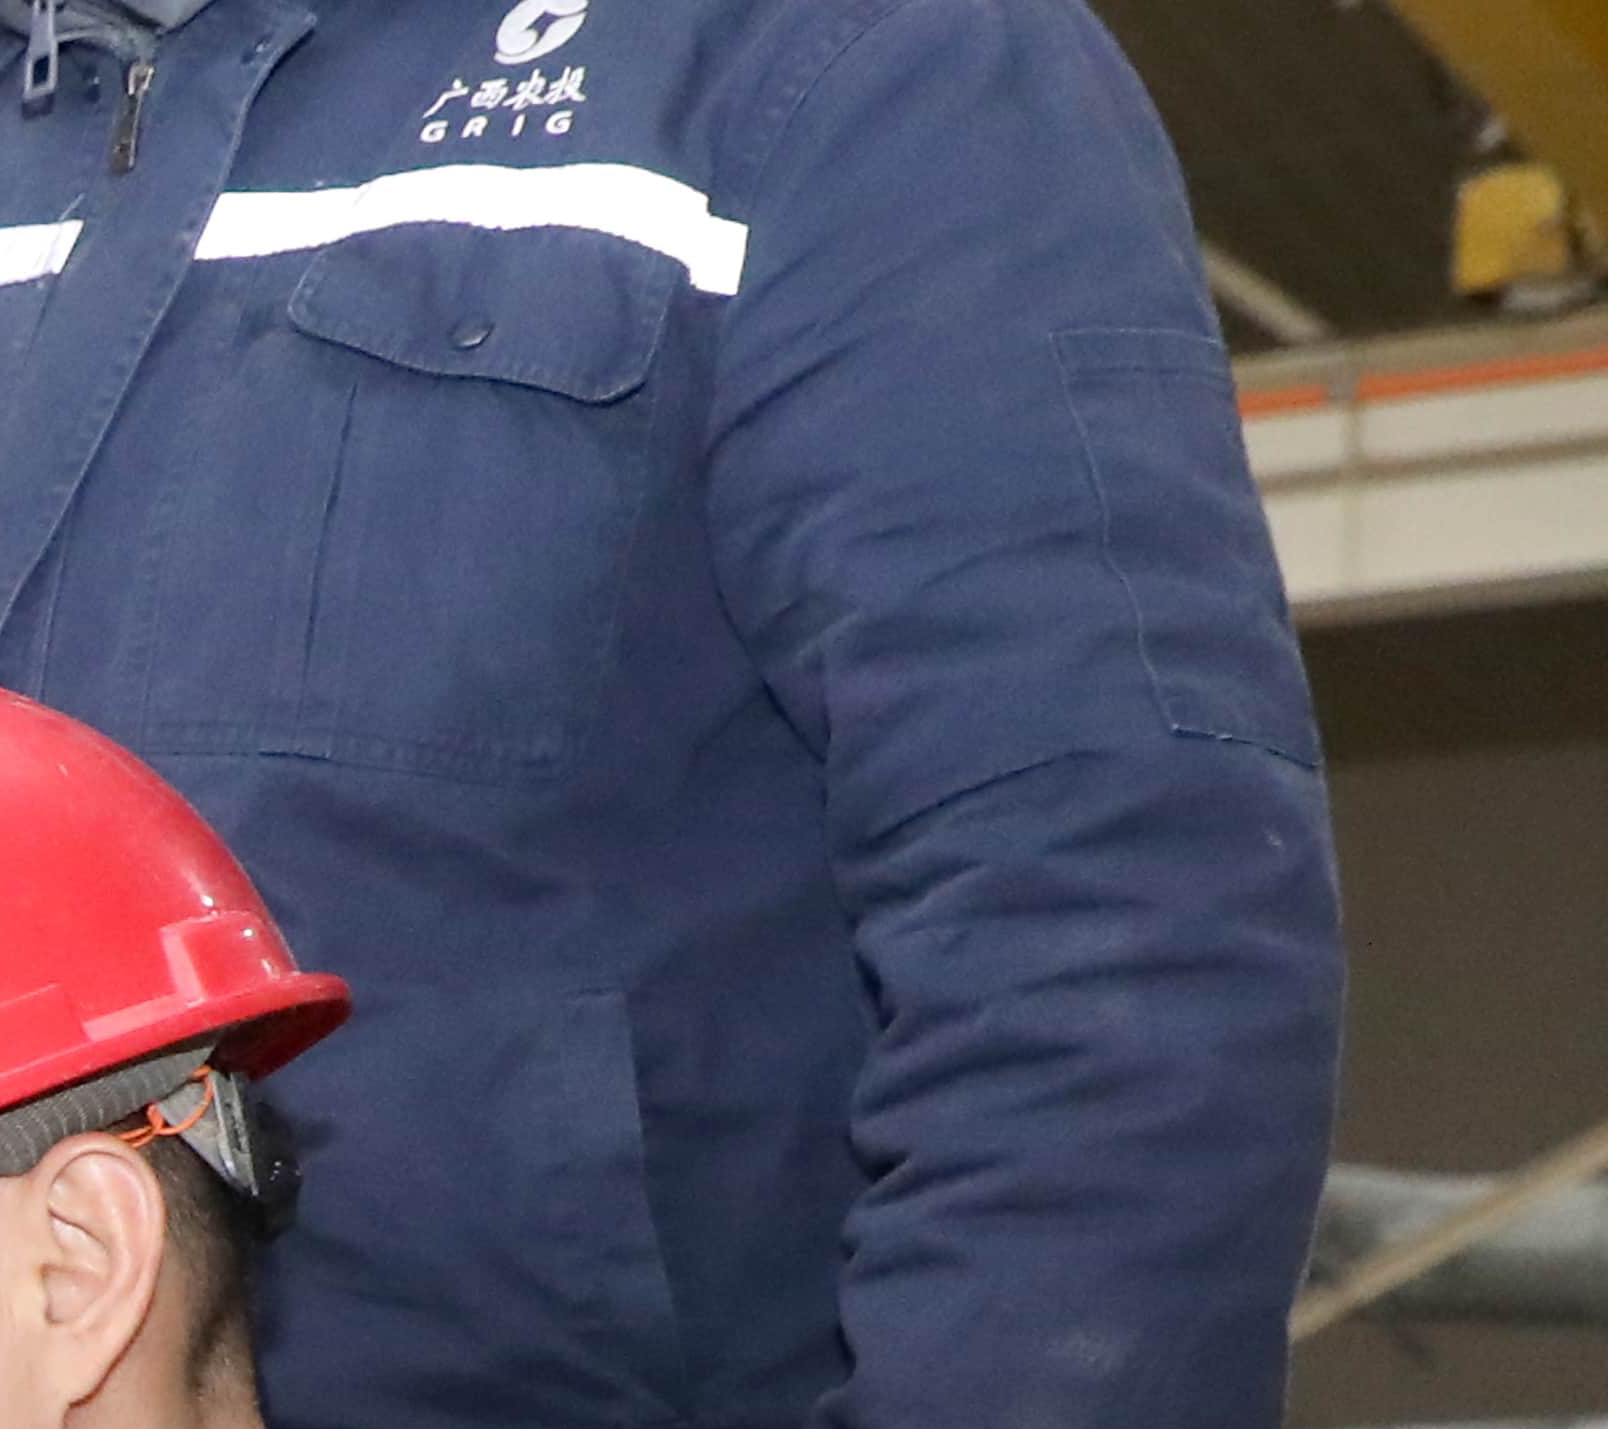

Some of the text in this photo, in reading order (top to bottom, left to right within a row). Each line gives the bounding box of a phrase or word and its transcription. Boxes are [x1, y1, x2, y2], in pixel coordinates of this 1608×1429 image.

[422, 66, 586, 118] 广西农投
[420, 111, 573, 142] GRIG
